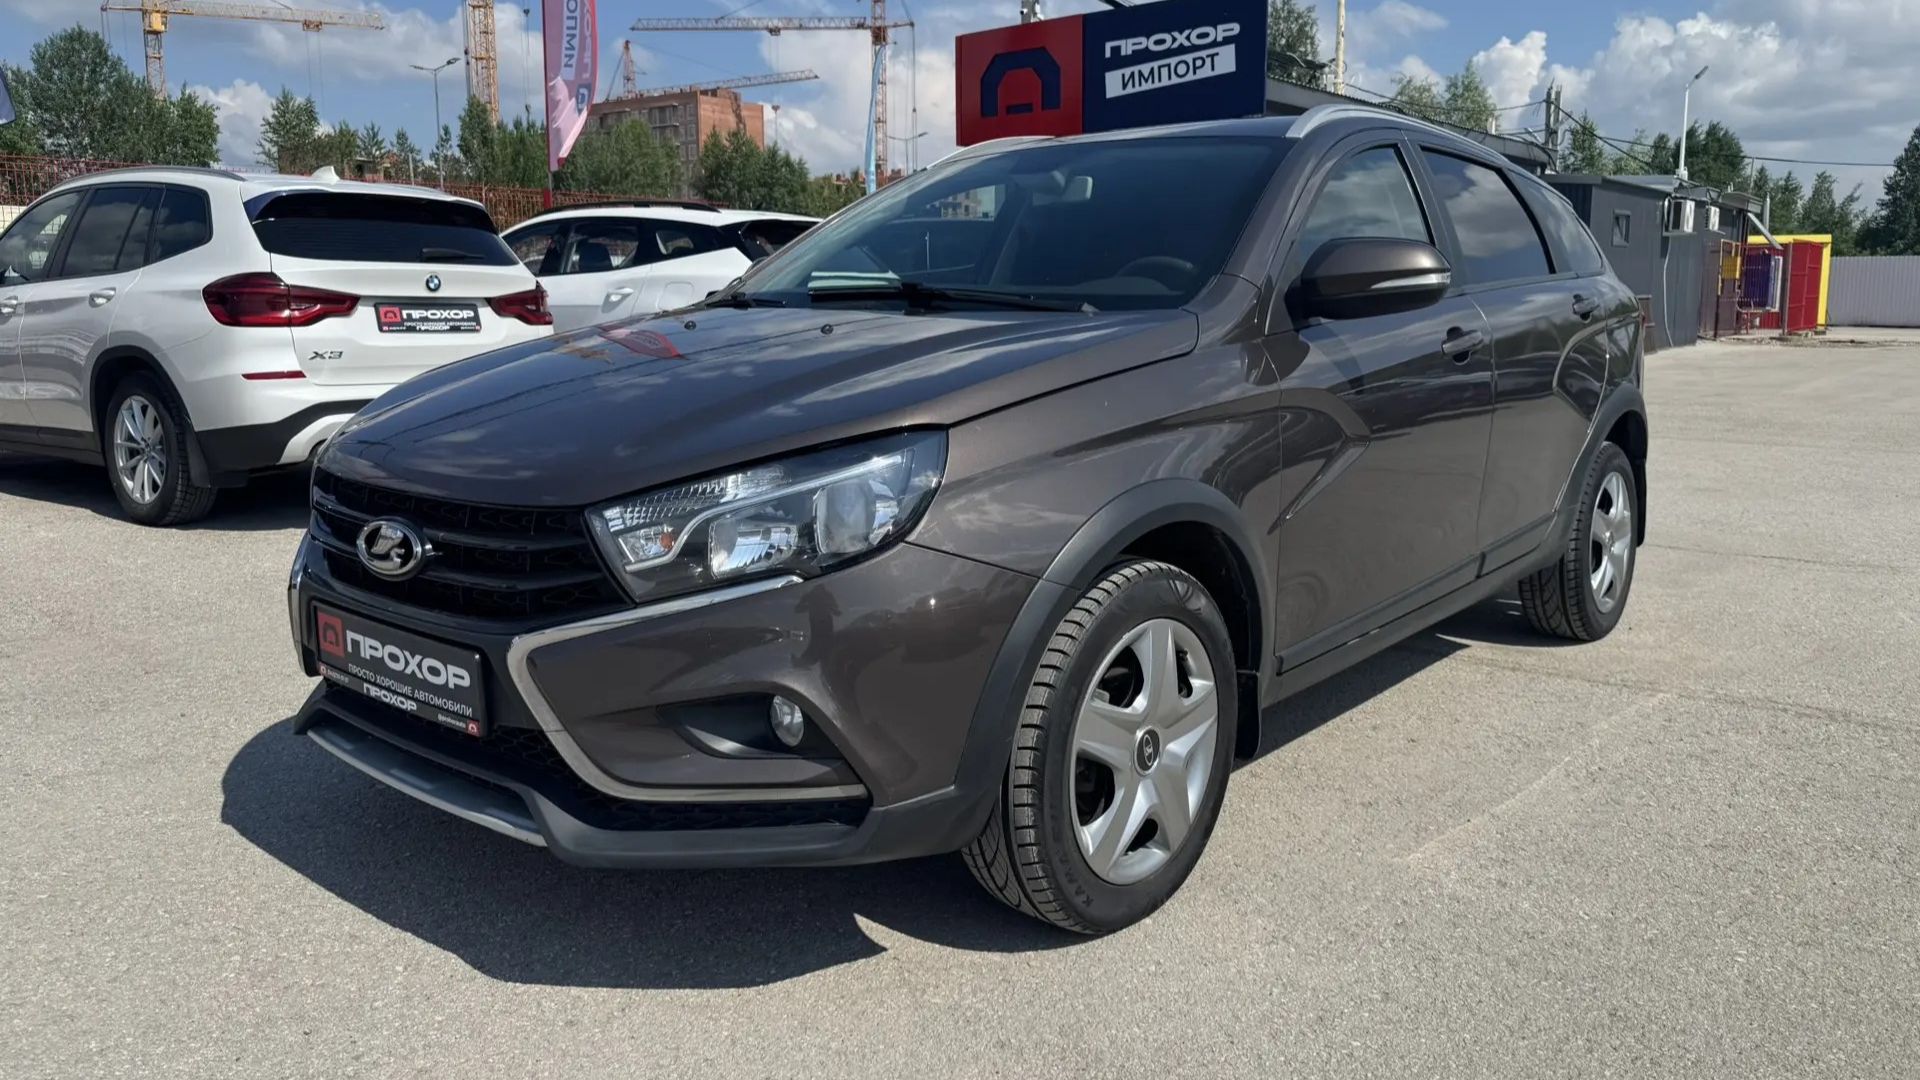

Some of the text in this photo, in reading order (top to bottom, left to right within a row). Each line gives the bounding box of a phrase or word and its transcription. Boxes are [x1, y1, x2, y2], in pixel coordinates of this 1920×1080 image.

[1105, 22, 1240, 58] ПРОХОР
[1121, 52, 1219, 91] ИМПОРТ
[401, 309, 475, 319] ПРОХОР
[308, 351, 344, 360] X3
[346, 629, 471, 689] ПРОХОР
[348, 663, 375, 682] ПРОСТО
[375, 674, 413, 697] ХОРОШИЕ
[413, 689, 473, 717] АВТОМОБИЛИ
[363, 683, 417, 711] ПРОХОР
